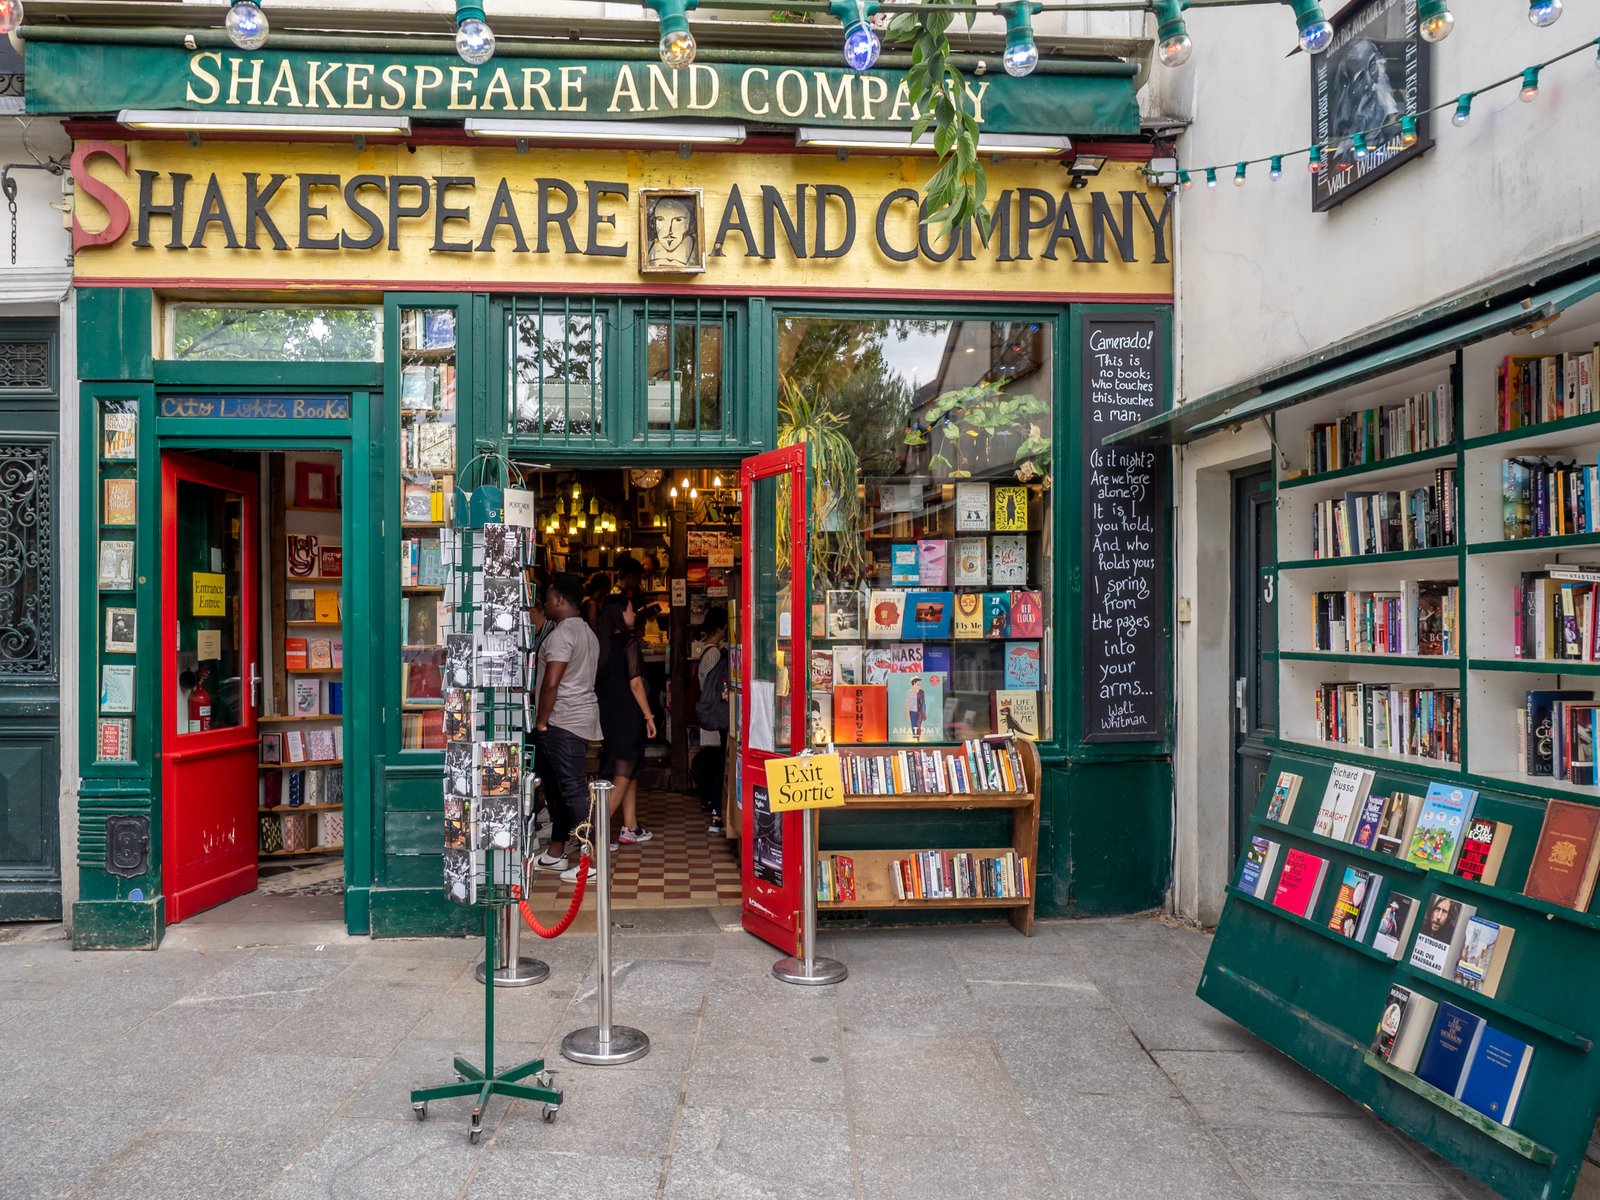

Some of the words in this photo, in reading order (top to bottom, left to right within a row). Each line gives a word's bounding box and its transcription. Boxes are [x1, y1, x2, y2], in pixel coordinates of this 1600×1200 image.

[186, 52, 588, 112] SHAKESPEARE
[607, 64, 720, 112] AND
[1328, 165, 1353, 196] WALT
[71, 140, 629, 257] SHAKESPEARE
[710, 183, 856, 259] AND
[876, 187, 1176, 265] COMPANY
[1090, 330, 1154, 351] Camerado!
[1095, 354, 1122, 367] This
[1130, 354, 1140, 366] is
[1100, 369, 1113, 378] no
[1092, 379, 1112, 390] Who
[1115, 380, 1153, 392] touches
[1116, 392, 1154, 407] touches
[161, 398, 214, 418] City
[220, 398, 286, 418] Lights
[1094, 410, 1102, 422] a
[1090, 449, 1103, 468] (Is
[1107, 452, 1116, 468] it
[1120, 452, 1154, 473] night?
[1090, 470, 1109, 486] Are
[1112, 475, 1126, 484] we
[1126, 472, 1150, 486] here
[1012, 488, 1026, 506] WEST
[1098, 484, 1146, 502] alone?)
[1094, 503, 1103, 518] It
[1113, 503, 1124, 517] is
[1132, 501, 1136, 518] I
[1097, 522, 1118, 536] you
[1092, 536, 1120, 552] And
[1127, 536, 1149, 550] who
[1099, 554, 1130, 570] holds
[195, 580, 224, 594] Entrance
[1095, 576, 1099, 594] I
[1108, 576, 1150, 600] spring
[1264, 574, 1274, 603] 3
[199, 595, 221, 608] Entrée
[1021, 604, 1032, 614] RED
[1103, 593, 1136, 614] from
[956, 622, 968, 630] Fly
[1017, 614, 1036, 623] CLOCKS
[1092, 613, 1112, 630] the
[1117, 616, 1150, 636] pages
[1104, 637, 1135, 656] into
[892, 648, 922, 662] MARS
[1100, 661, 1136, 683] your
[1100, 680, 1152, 698] arms...
[1108, 701, 1134, 716] Walt
[1102, 715, 1148, 729] Whitman
[892, 726, 940, 736] ANATOMY
[784, 764, 823, 784] Exit
[1332, 766, 1359, 780] Richard
[778, 782, 834, 804] Sortie
[1334, 780, 1355, 793] Russo
[1318, 808, 1348, 822] STRAIGHT
[1473, 824, 1492, 834] JOHN
[1424, 937, 1448, 952] STRUGGLE
[1414, 948, 1425, 958] KARL
[1412, 954, 1442, 972] KNAUSGAARD
[1440, 1030, 1462, 1044] MORMON
